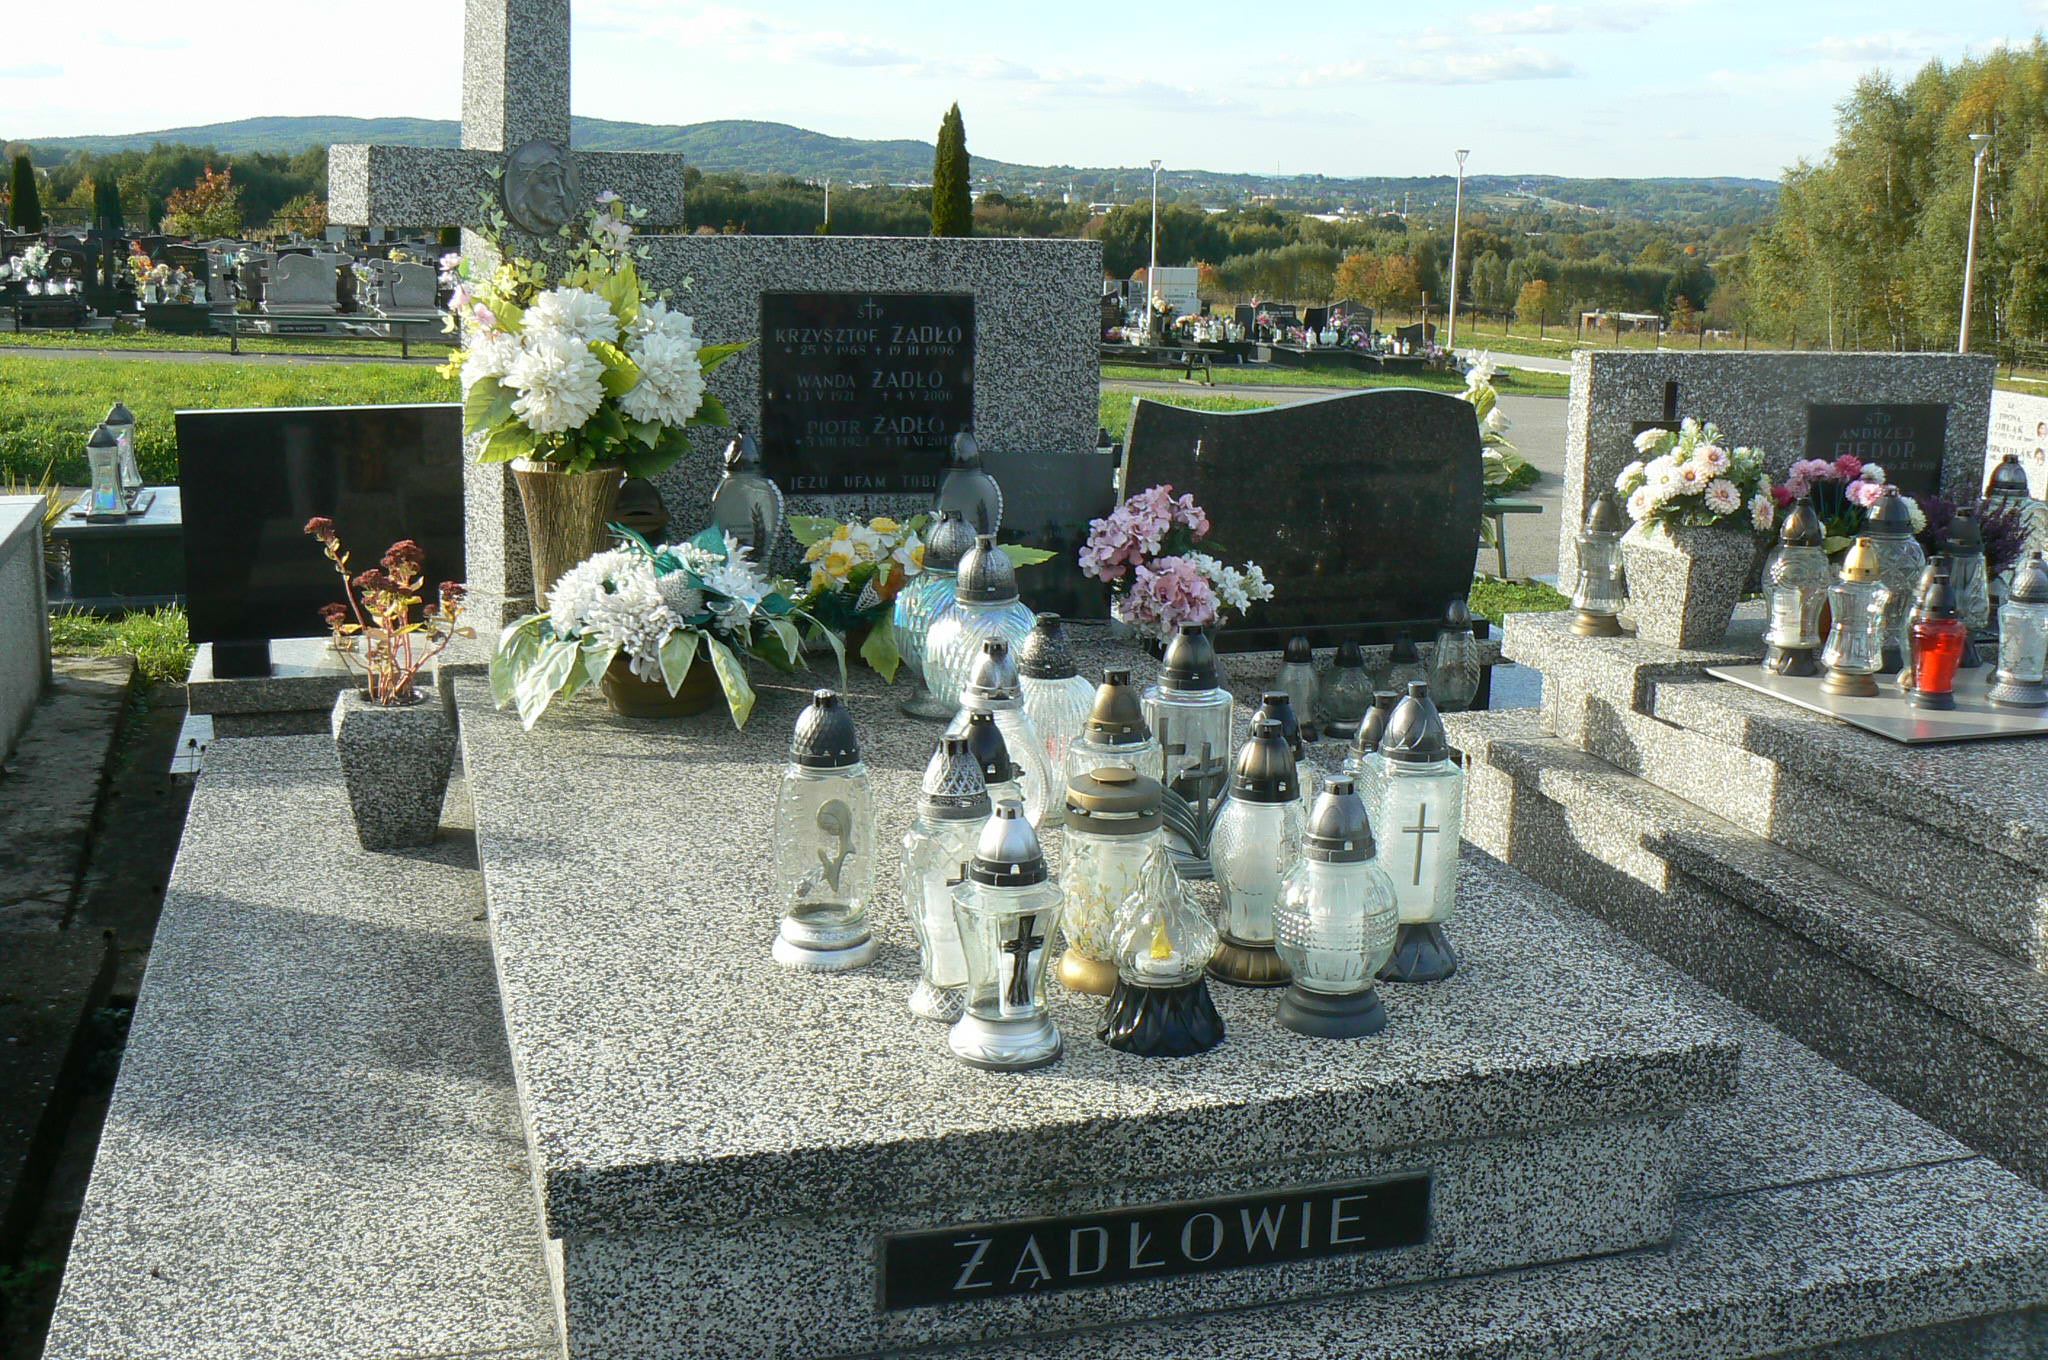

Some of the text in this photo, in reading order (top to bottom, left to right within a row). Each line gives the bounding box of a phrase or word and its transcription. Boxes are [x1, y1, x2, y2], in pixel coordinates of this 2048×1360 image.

[775, 328, 879, 344] KRZYSZTOF
[797, 374, 856, 389] WANDA
[806, 419, 861, 435] PIOTR
[790, 475, 829, 491] JEZU
[844, 475, 887, 489] UFAM
[953, 1194, 1369, 1290] ŻĄDŁOWIE
